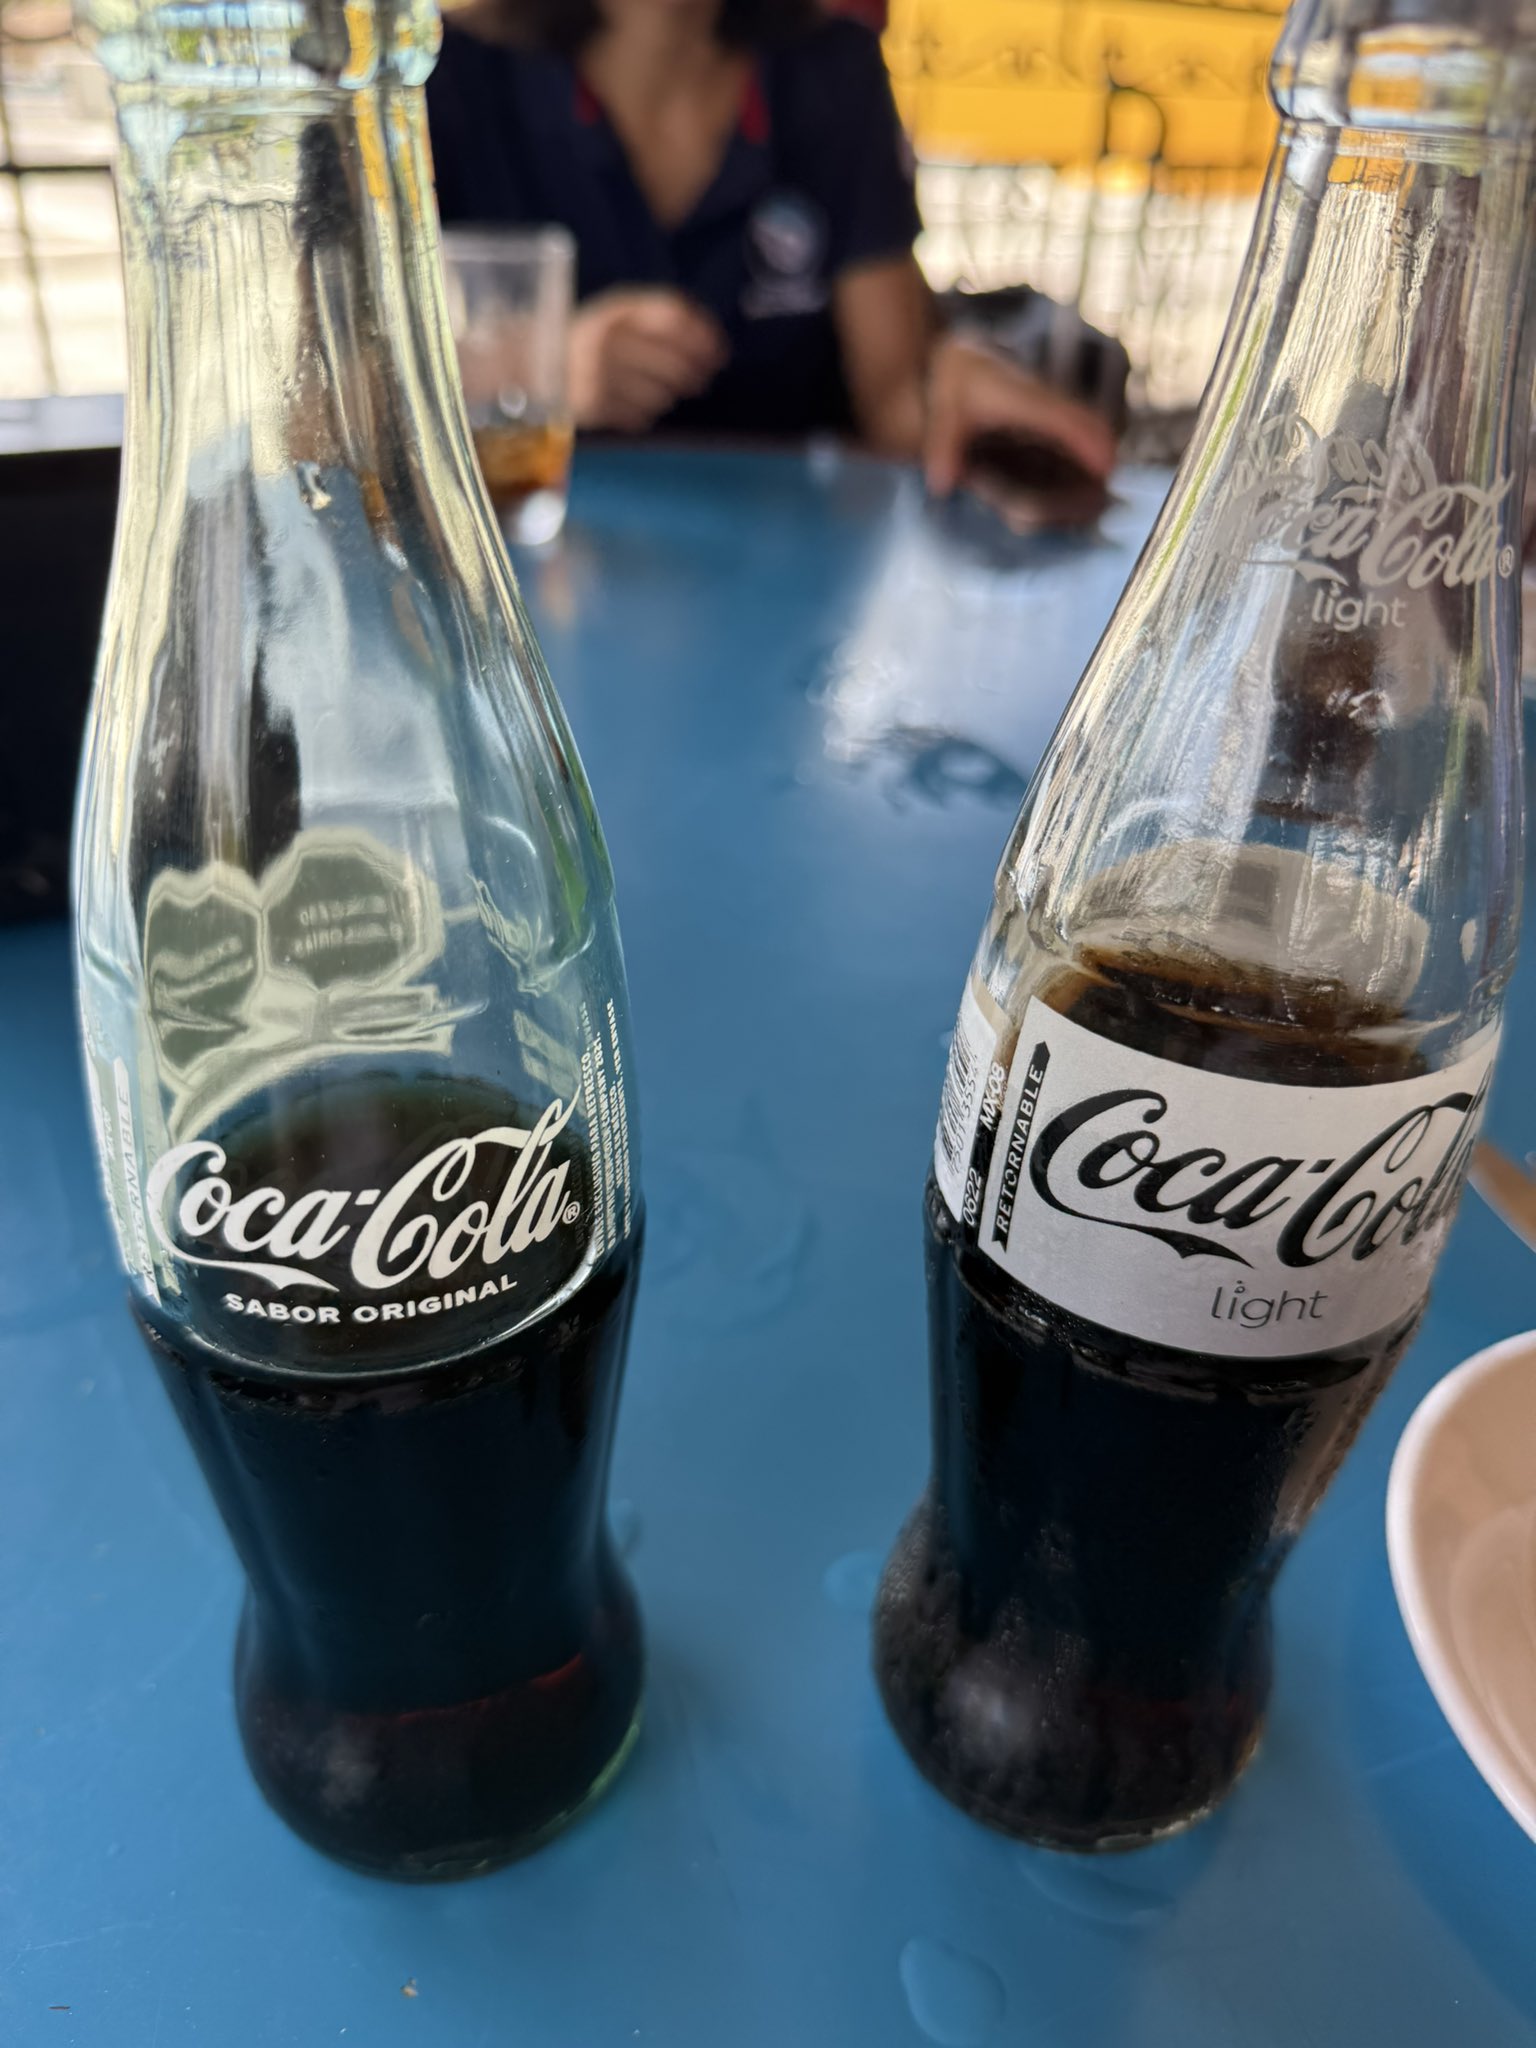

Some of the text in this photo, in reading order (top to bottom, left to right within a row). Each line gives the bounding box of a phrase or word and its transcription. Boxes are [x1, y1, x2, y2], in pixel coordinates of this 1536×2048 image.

[1311, 581, 1406, 632] light
[581, 1047, 597, 1118] REFRESCO.
[597, 1069, 611, 1128] COMPANY
[587, 1116, 600, 1152] PARA
[995, 1064, 1044, 1234] RETORNABLE
[590, 1151, 604, 1215] EXCLUSIVO
[962, 1167, 983, 1227] 0622
[224, 1275, 518, 1325] SABOR ORIGINAL
[1210, 1280, 1328, 1330] light
